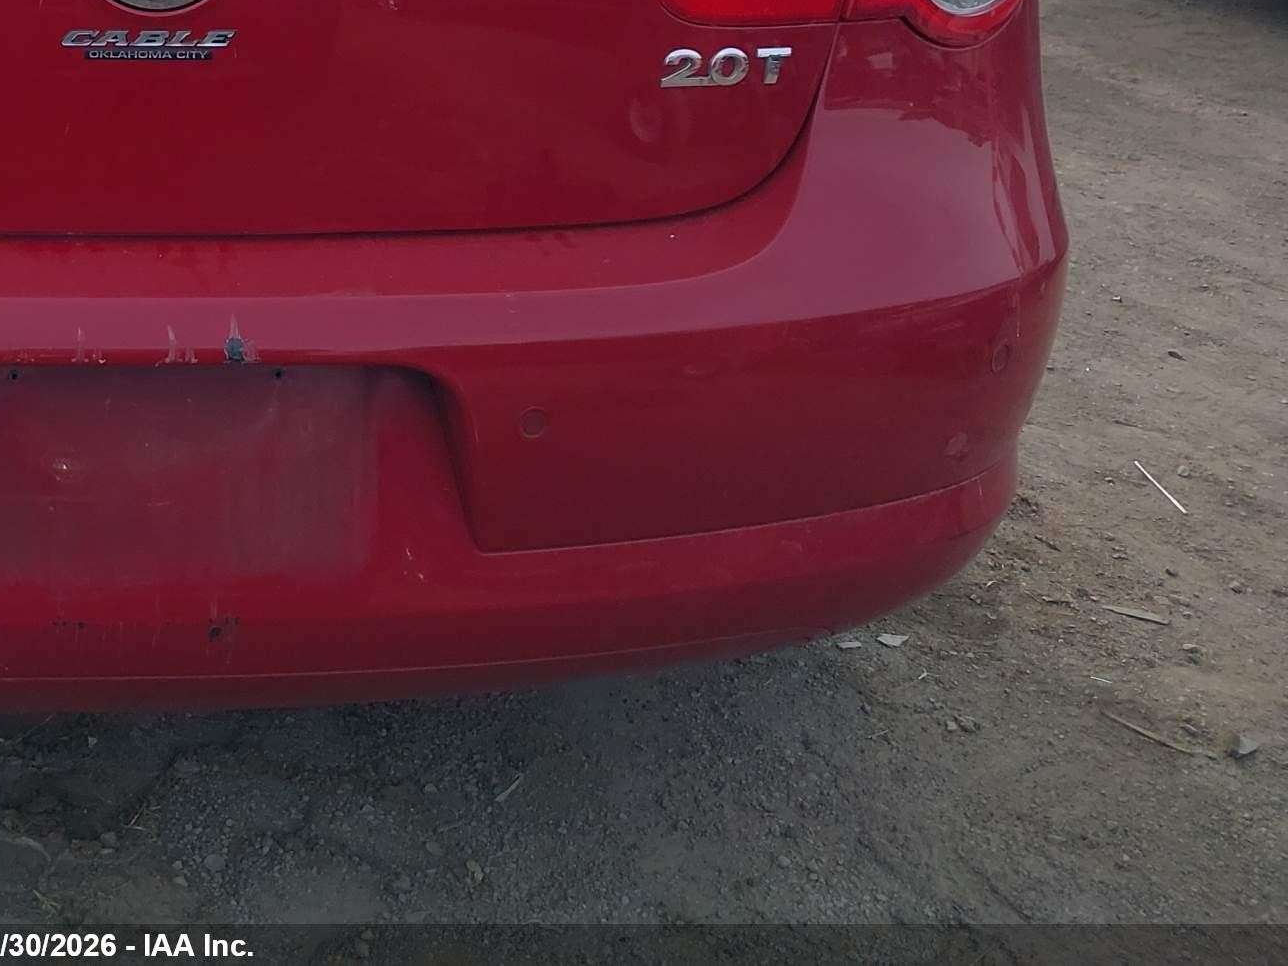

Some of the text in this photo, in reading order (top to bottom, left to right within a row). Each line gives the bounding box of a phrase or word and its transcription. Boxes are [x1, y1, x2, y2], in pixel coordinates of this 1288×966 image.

[61, 30, 237, 47] CABLE
[88, 50, 209, 60] OKLAHOMA CITY
